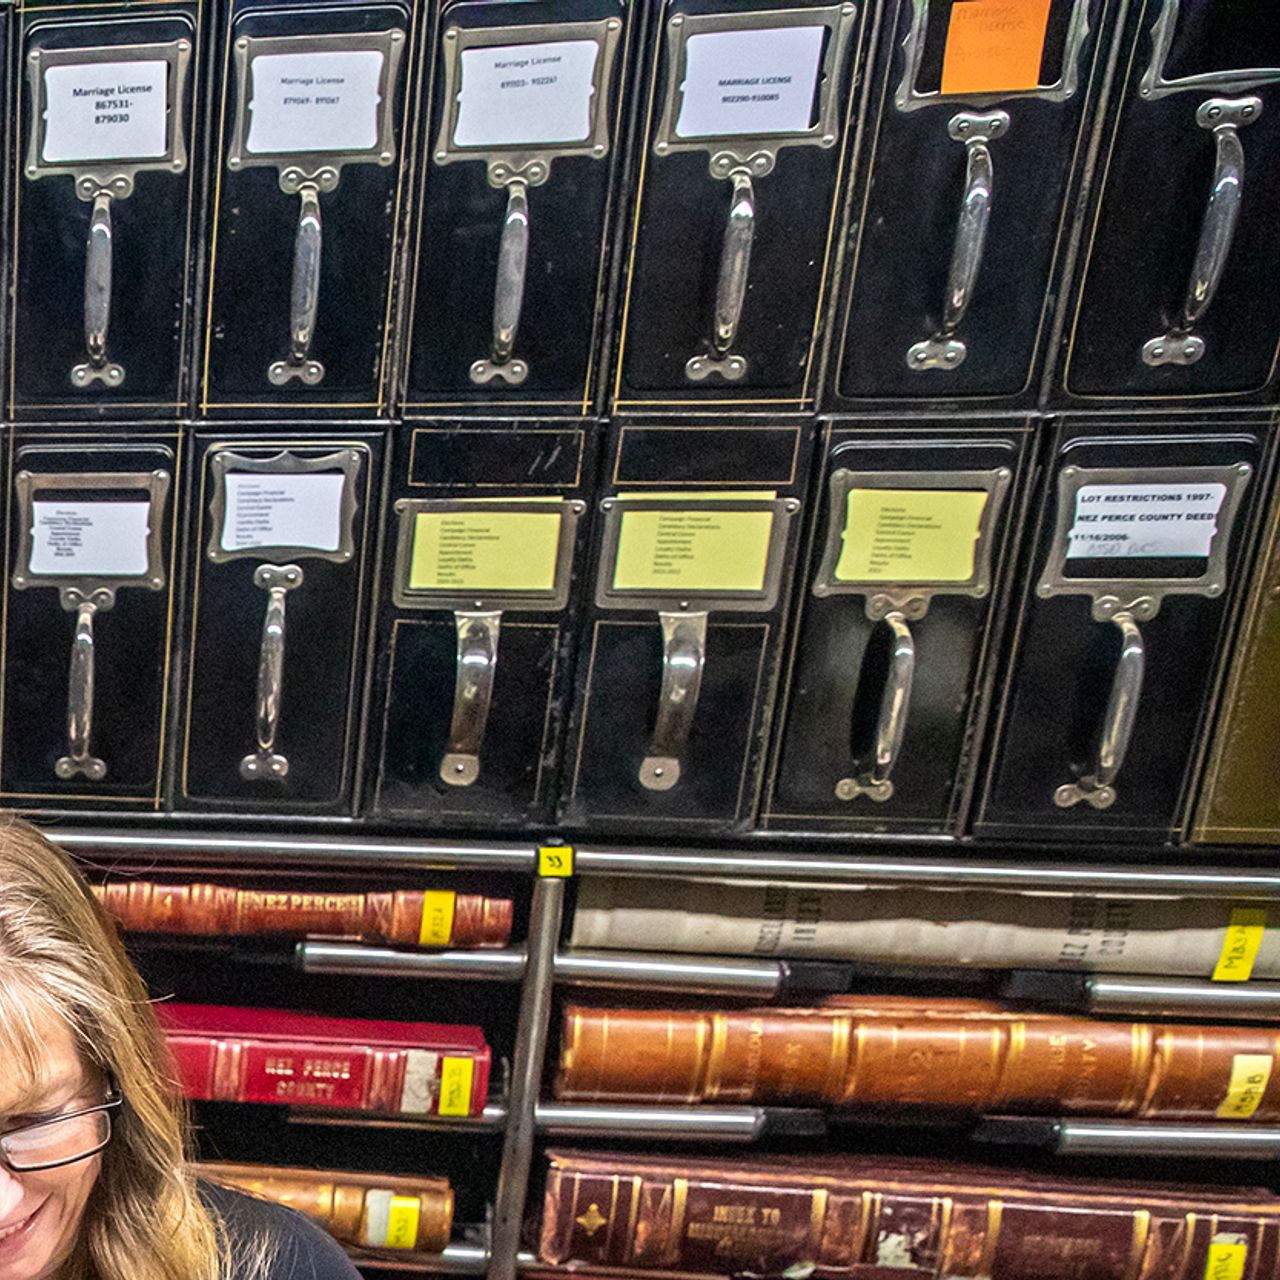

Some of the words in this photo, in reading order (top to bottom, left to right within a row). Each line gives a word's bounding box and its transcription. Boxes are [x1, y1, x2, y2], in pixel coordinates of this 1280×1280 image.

[494, 59, 529, 69] Marriage
[531, 55, 562, 65] License
[281, 78, 314, 86] Marriage
[761, 76, 792, 84] LICENSE
[72, 88, 115, 97] Marriage
[117, 84, 153, 93] License
[95, 100, 133, 110] 867531-
[95, 114, 130, 124] 879030
[1081, 495, 1101, 503] LOT
[1104, 493, 1183, 503] RESTRICTIONS
[1186, 492, 1215, 501] 1997-
[1101, 514, 1135, 522] PERCE
[1138, 513, 1182, 522] COUNTY
